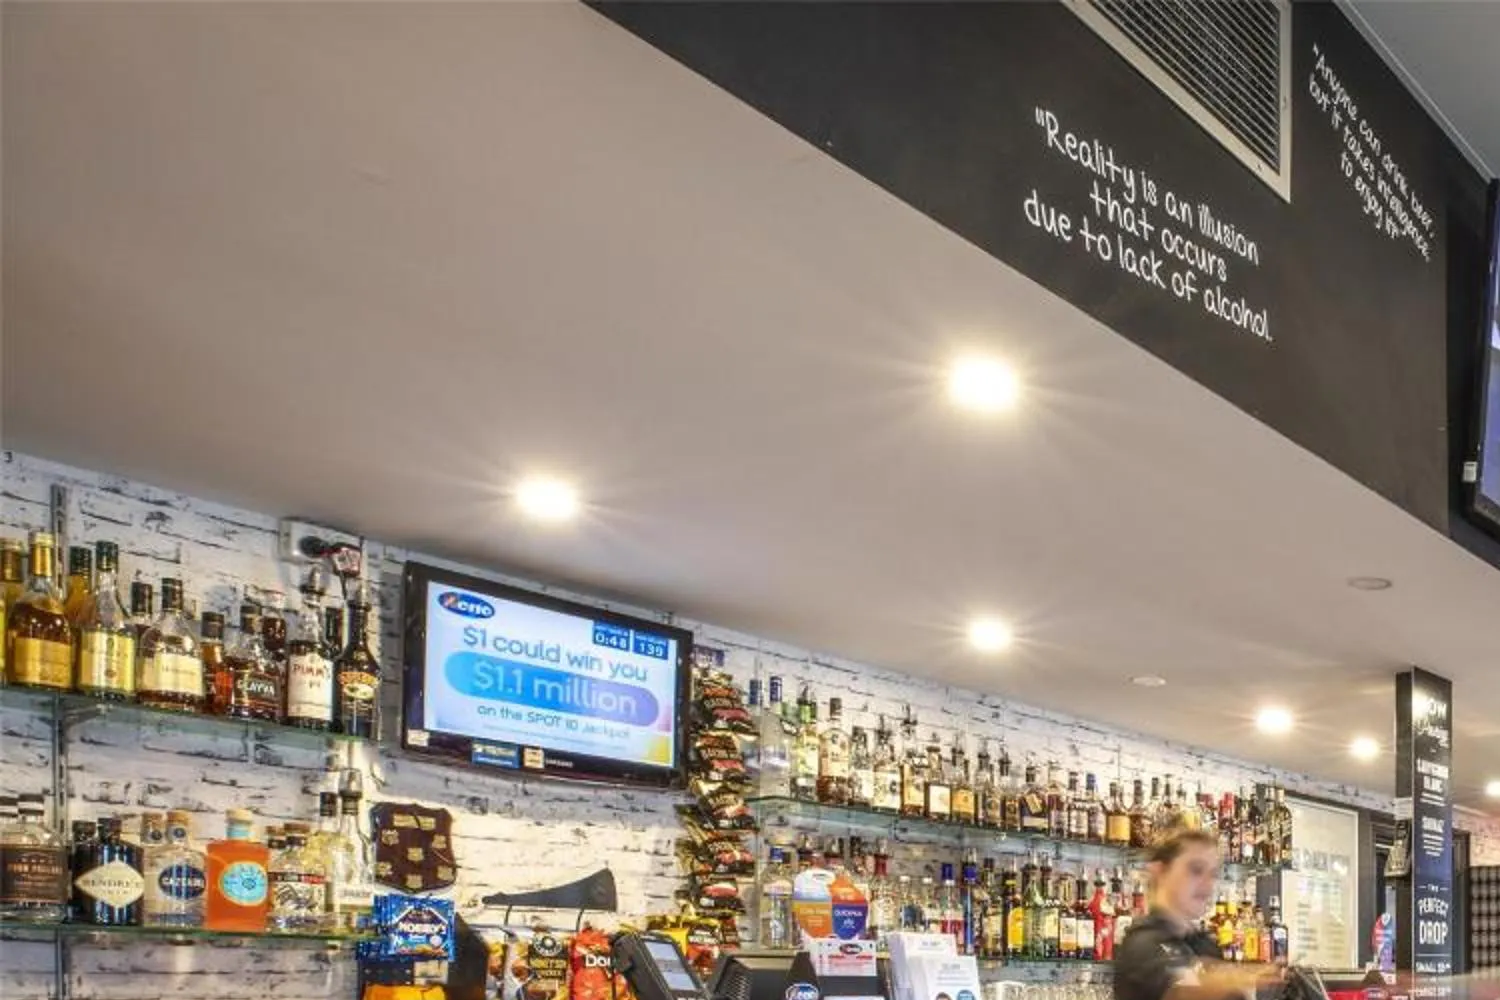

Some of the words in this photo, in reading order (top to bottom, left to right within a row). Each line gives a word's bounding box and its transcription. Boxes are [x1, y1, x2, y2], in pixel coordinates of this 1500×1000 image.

[1141, 171, 1158, 207] is
[1165, 191, 1193, 228] an
[1197, 204, 1260, 267] illusion
[1340, 151, 1353, 177] to
[1354, 175, 1383, 230] enjoy
[1023, 188, 1073, 242] due
[1079, 216, 1113, 261] to
[1117, 234, 1167, 290] lack
[1171, 270, 1199, 302] of
[1090, 179, 1155, 241] that
[1161, 227, 1228, 282] occurs
[463, 624, 488, 649] $1
[493, 635, 561, 664] could
[566, 650, 603, 673] win
[608, 659, 649, 682] you
[473, 657, 524, 696] $1.1
[533, 678, 637, 716] million
[477, 704, 497, 716] on
[500, 707, 523, 722] the
[527, 710, 561, 729] SPOT
[1417, 897, 1449, 918] PERFECT
[1419, 919, 1449, 945] DROP
